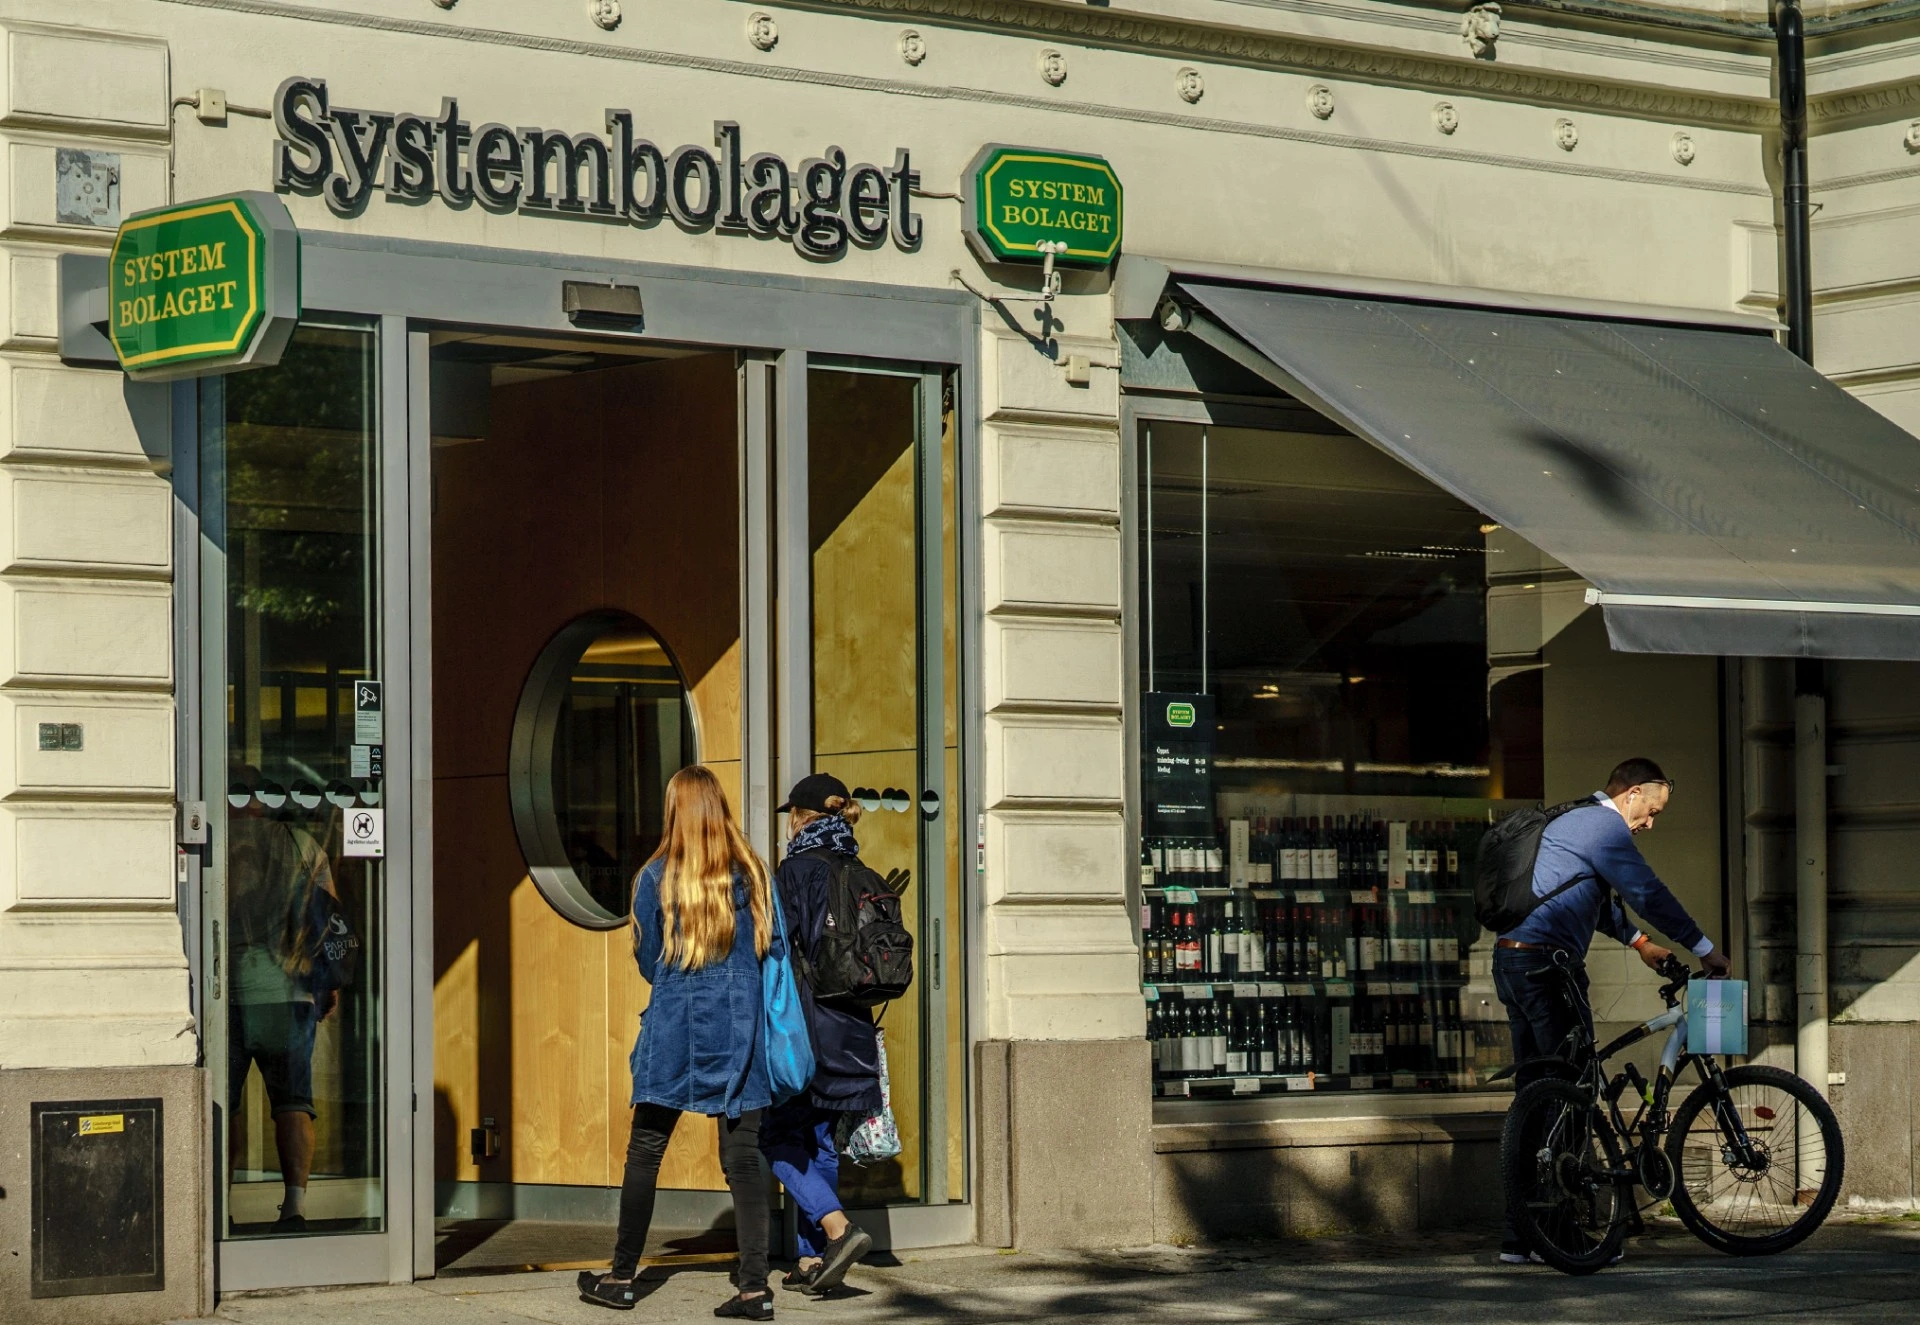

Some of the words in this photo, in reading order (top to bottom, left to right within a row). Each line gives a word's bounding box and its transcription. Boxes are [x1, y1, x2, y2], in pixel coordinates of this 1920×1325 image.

[275, 78, 923, 258] Systembolaget
[1009, 178, 1105, 206] SYSTEM
[1002, 205, 1112, 234] BOLAGET
[124, 242, 226, 287] SYSTEM
[119, 280, 237, 328] BOLAGET
[327, 949, 347, 960] CUP
